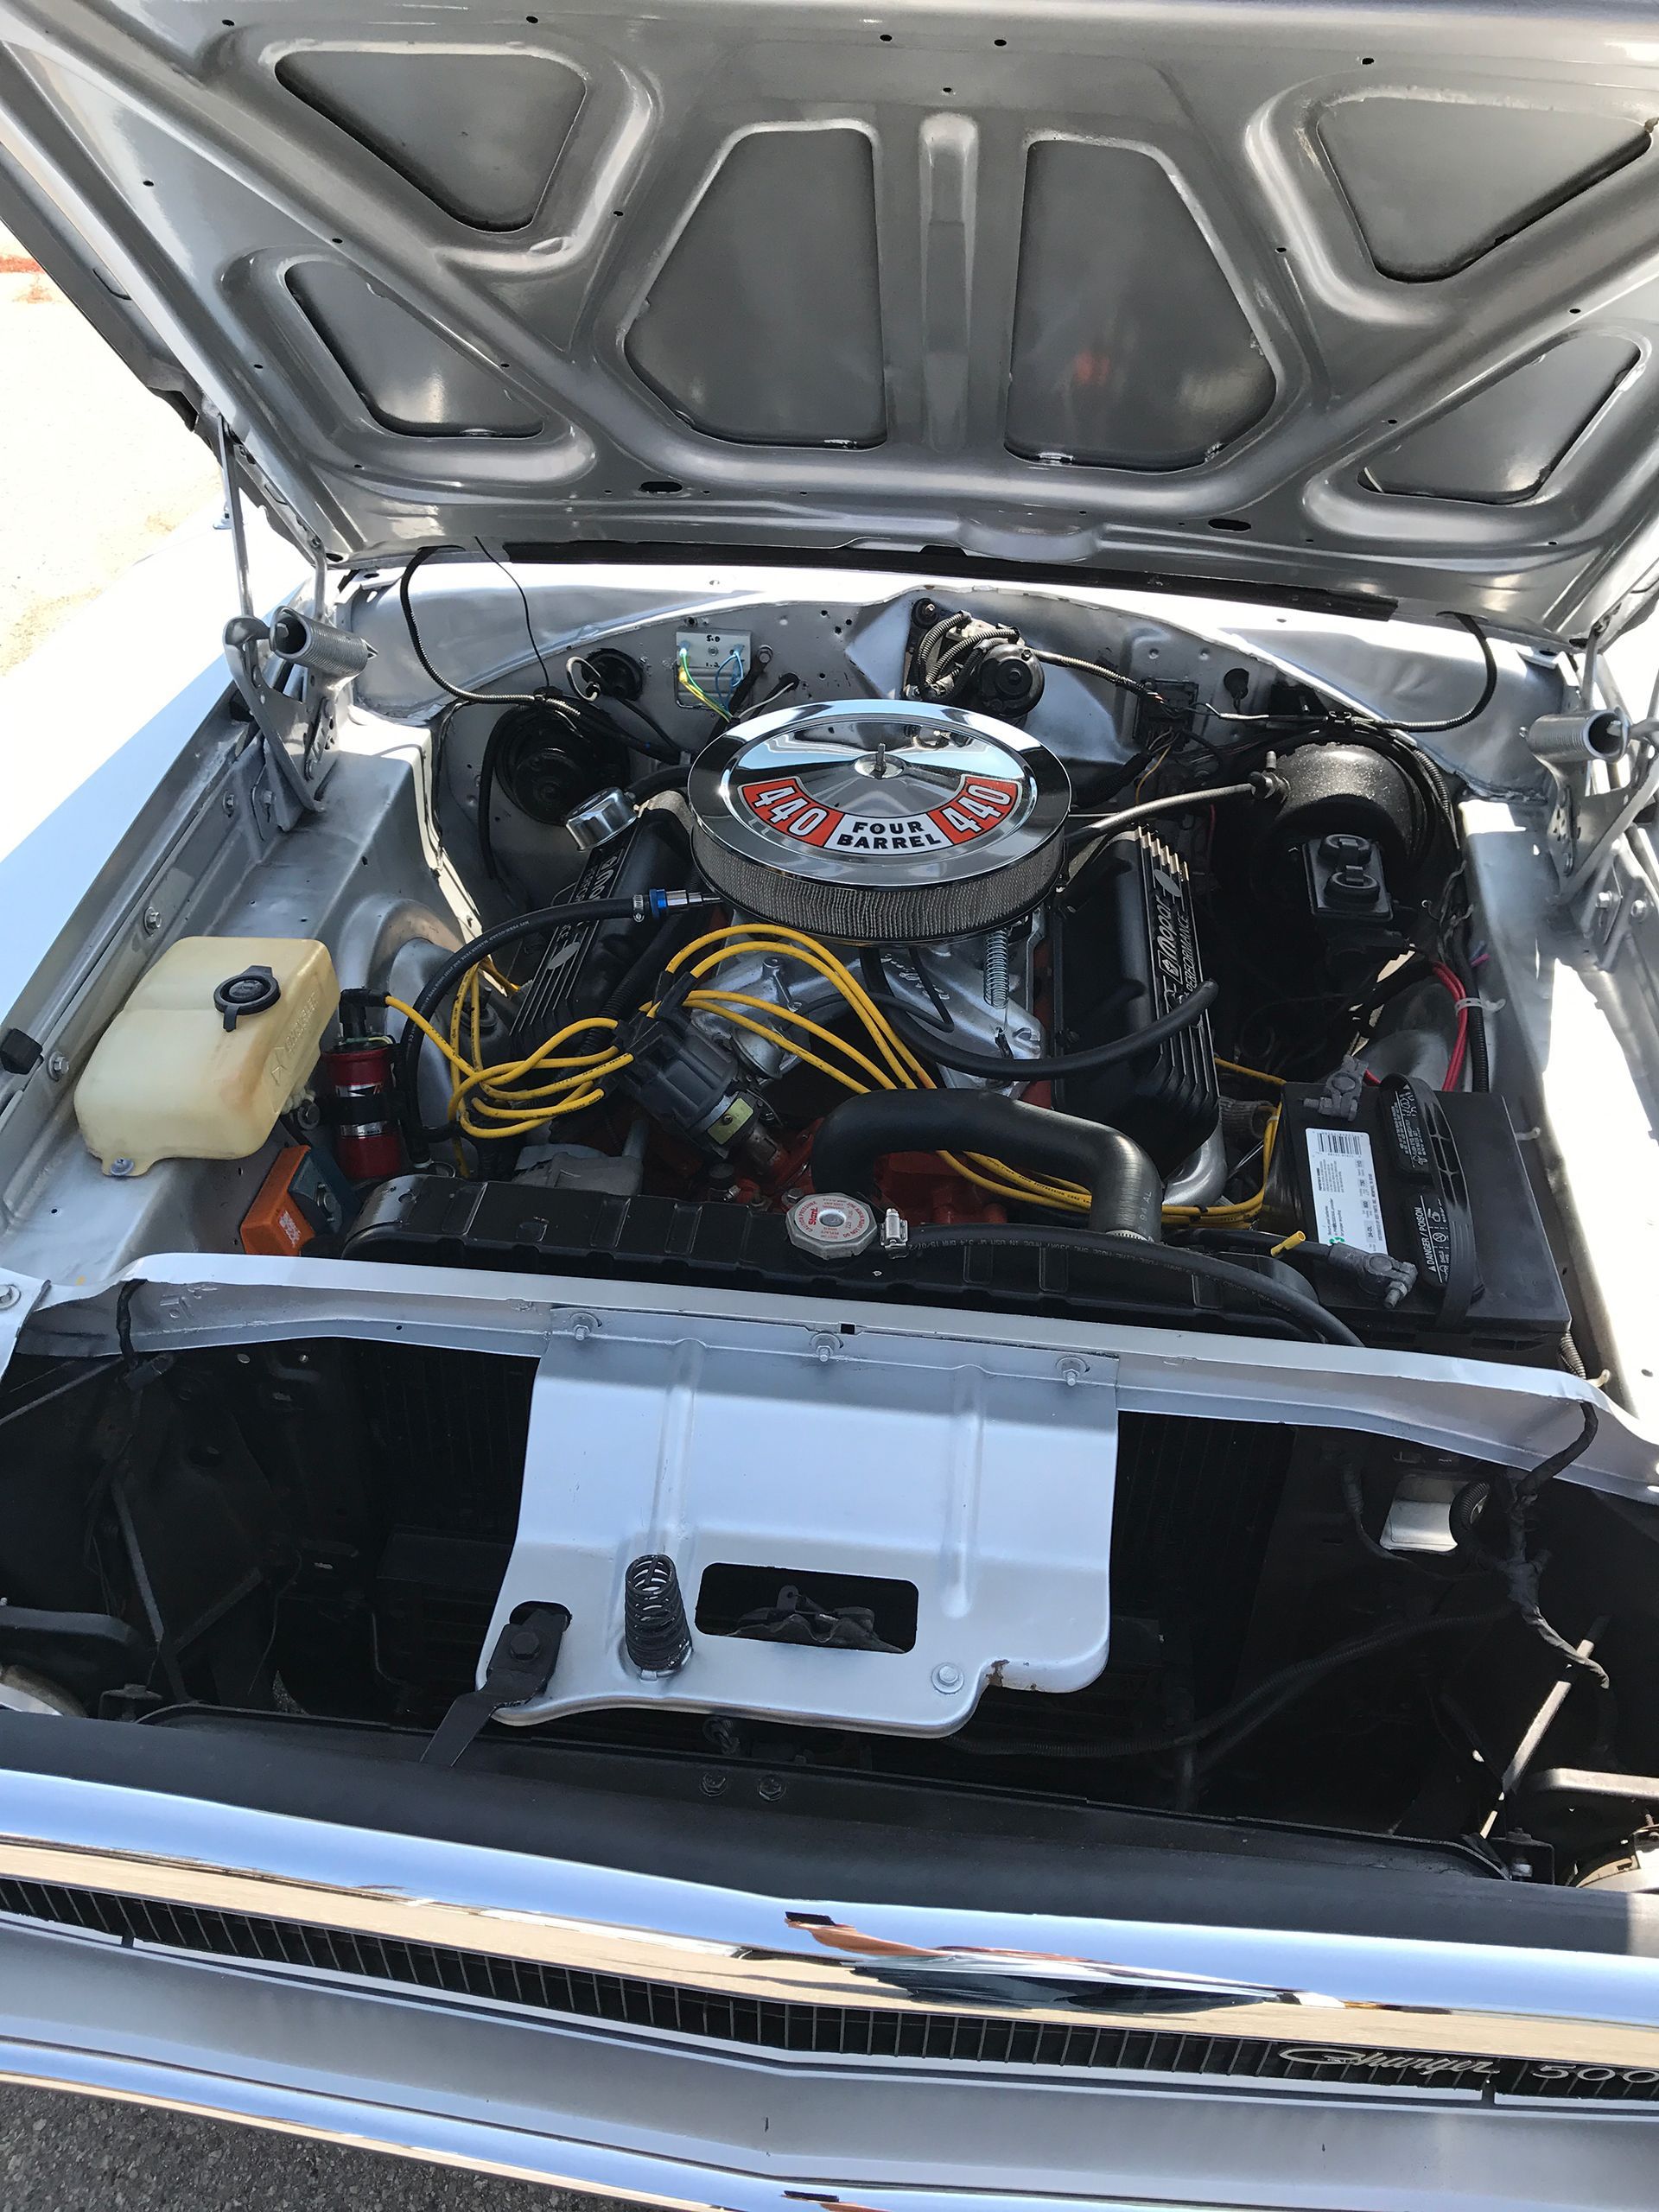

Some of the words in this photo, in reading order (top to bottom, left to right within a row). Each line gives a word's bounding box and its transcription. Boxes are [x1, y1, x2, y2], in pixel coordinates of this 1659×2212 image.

[754, 786, 828, 836] 440
[853, 821, 925, 835] FOUR
[942, 785, 1012, 834] 440
[836, 833, 941, 849] BARREL
[1155, 895, 1178, 961] Mopar
[1178, 911, 1198, 992] PERFORMANCE
[1414, 1207, 1427, 1231] POISON
[1421, 1237, 1435, 1265] DANGER
[1278, 2047, 1501, 2075] Charger
[1532, 2064, 1659, 2084] 500
